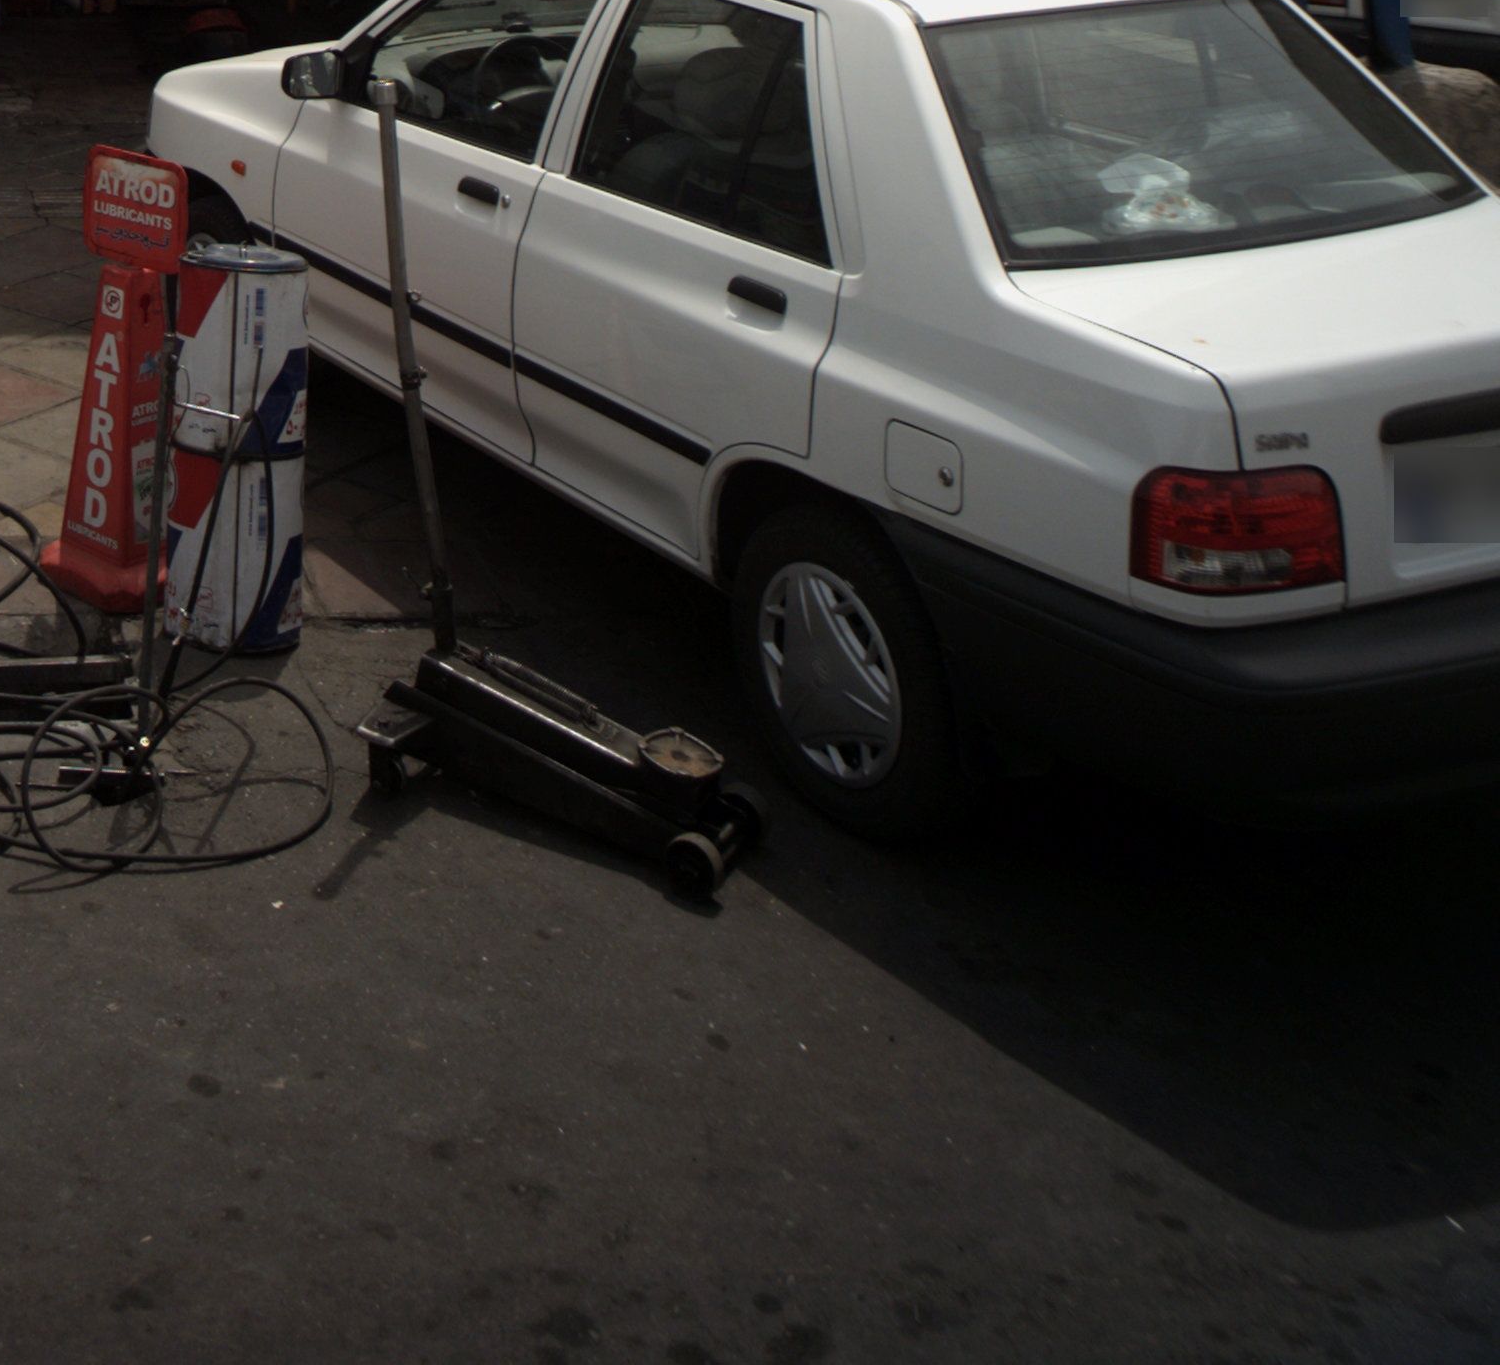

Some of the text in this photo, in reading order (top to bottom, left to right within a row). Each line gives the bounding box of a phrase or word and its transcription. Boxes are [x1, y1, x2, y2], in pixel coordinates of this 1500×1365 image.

[95, 170, 176, 209] ATROD
[93, 199, 173, 231] LUBRICANTS
[83, 331, 121, 529] ATROD
[66, 519, 119, 551] LUBRICANTS
